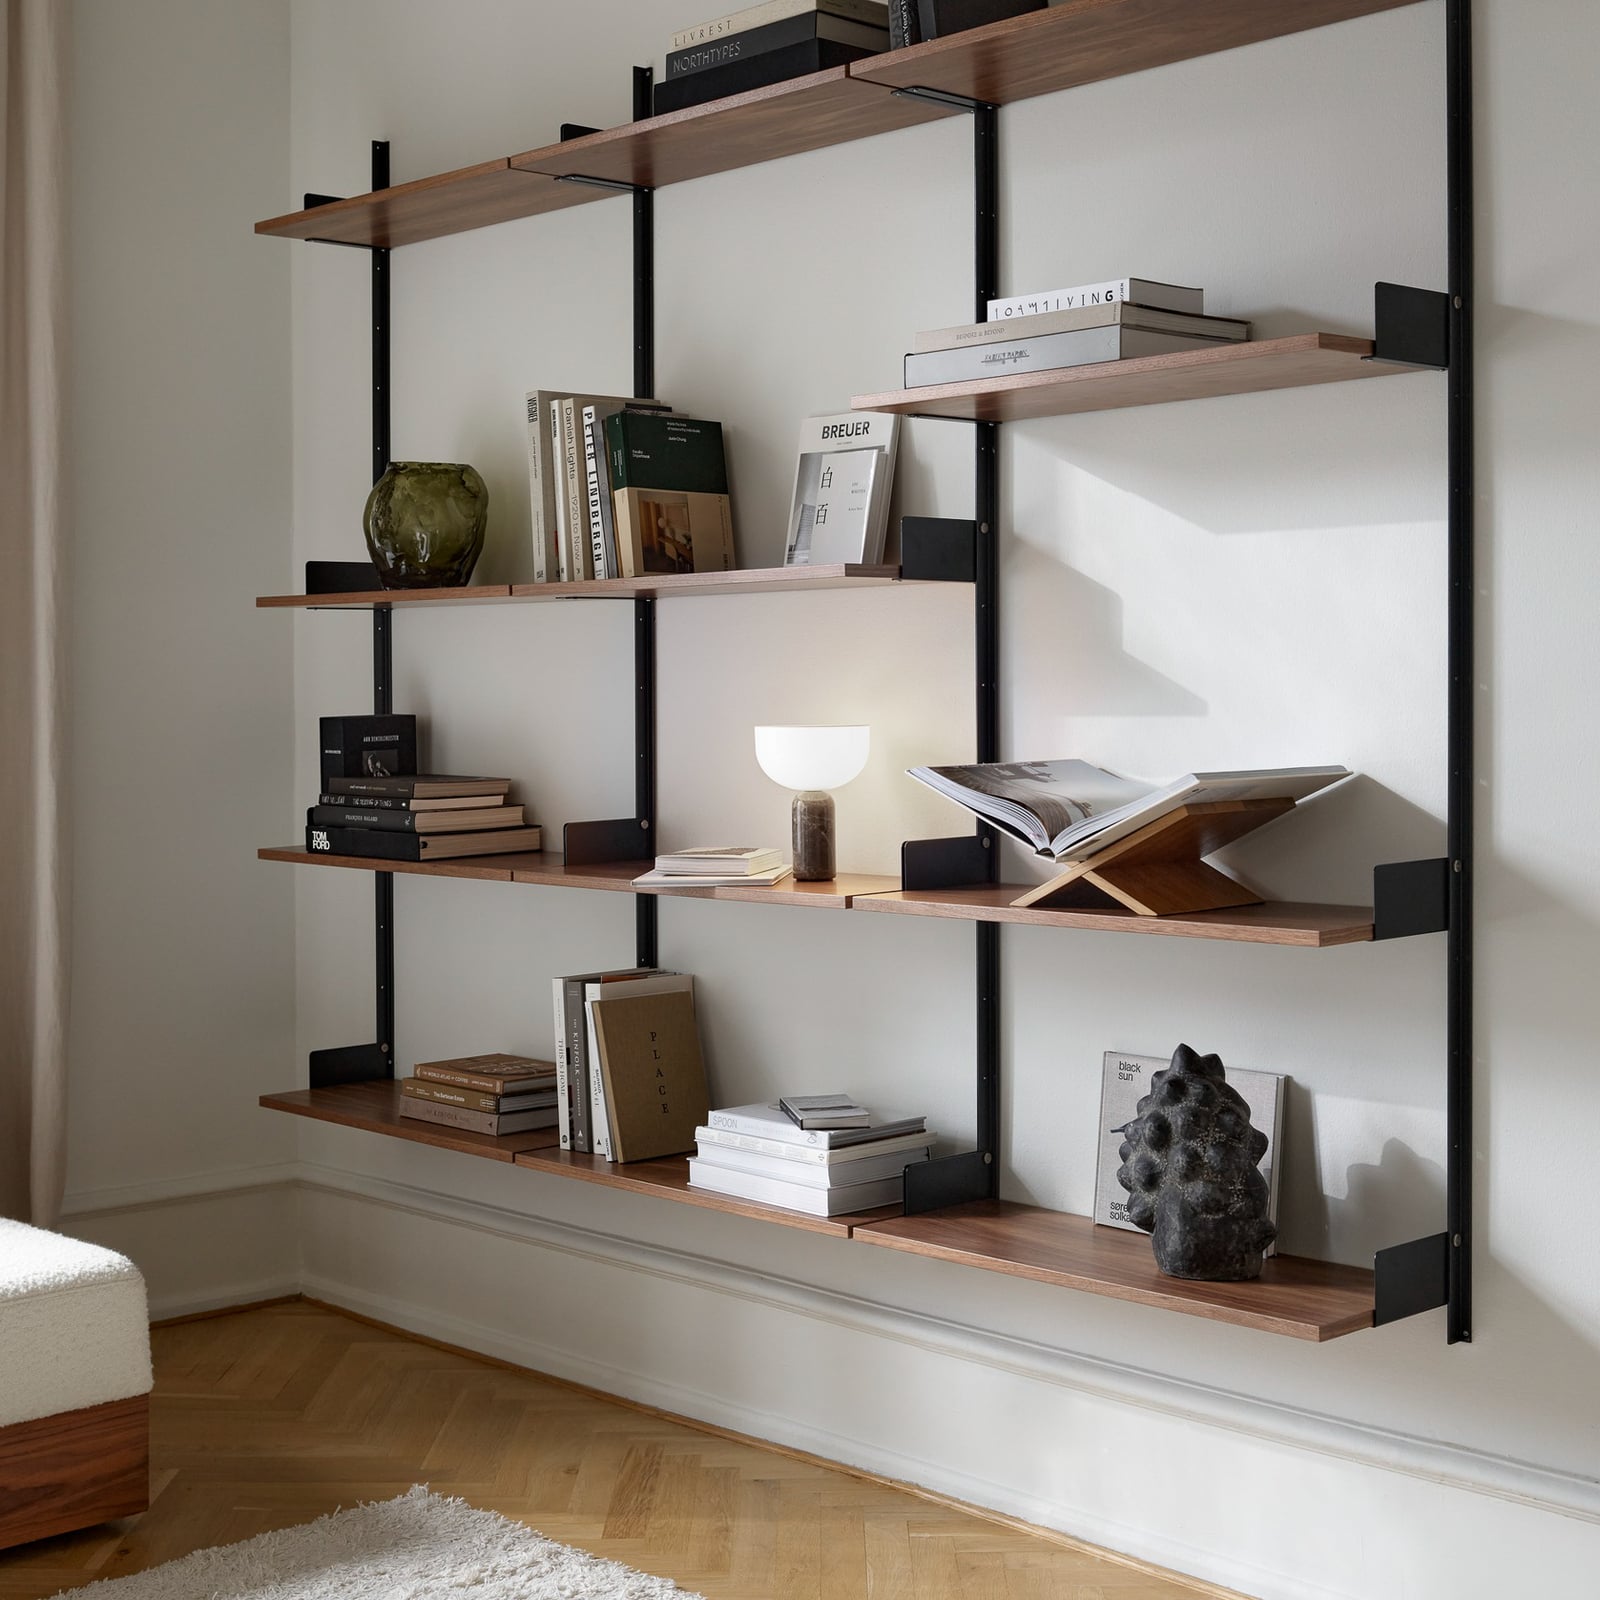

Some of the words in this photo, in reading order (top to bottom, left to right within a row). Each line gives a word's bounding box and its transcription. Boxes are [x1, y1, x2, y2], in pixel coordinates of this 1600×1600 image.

[673, 41, 741, 73] NORTHTYPES
[565, 406, 575, 445] Danish
[821, 421, 870, 440] BREUER
[584, 411, 596, 461] PETER
[566, 446, 576, 480] Lights
[571, 495, 580, 521] 1920
[588, 470, 603, 562] LINDBERGH
[573, 523, 579, 534] to
[312, 831, 327, 841] TOM
[312, 840, 331, 850] FORD
[558, 1039, 566, 1060] THIS
[572, 1032, 580, 1076] KINFOLK
[559, 1061, 565, 1070] IS
[649, 1031, 670, 1114] PLACE
[1119, 1060, 1141, 1073] black
[1118, 1071, 1134, 1081] sun
[712, 1115, 738, 1129] SPOON
[1110, 1201, 1128, 1212] søre
